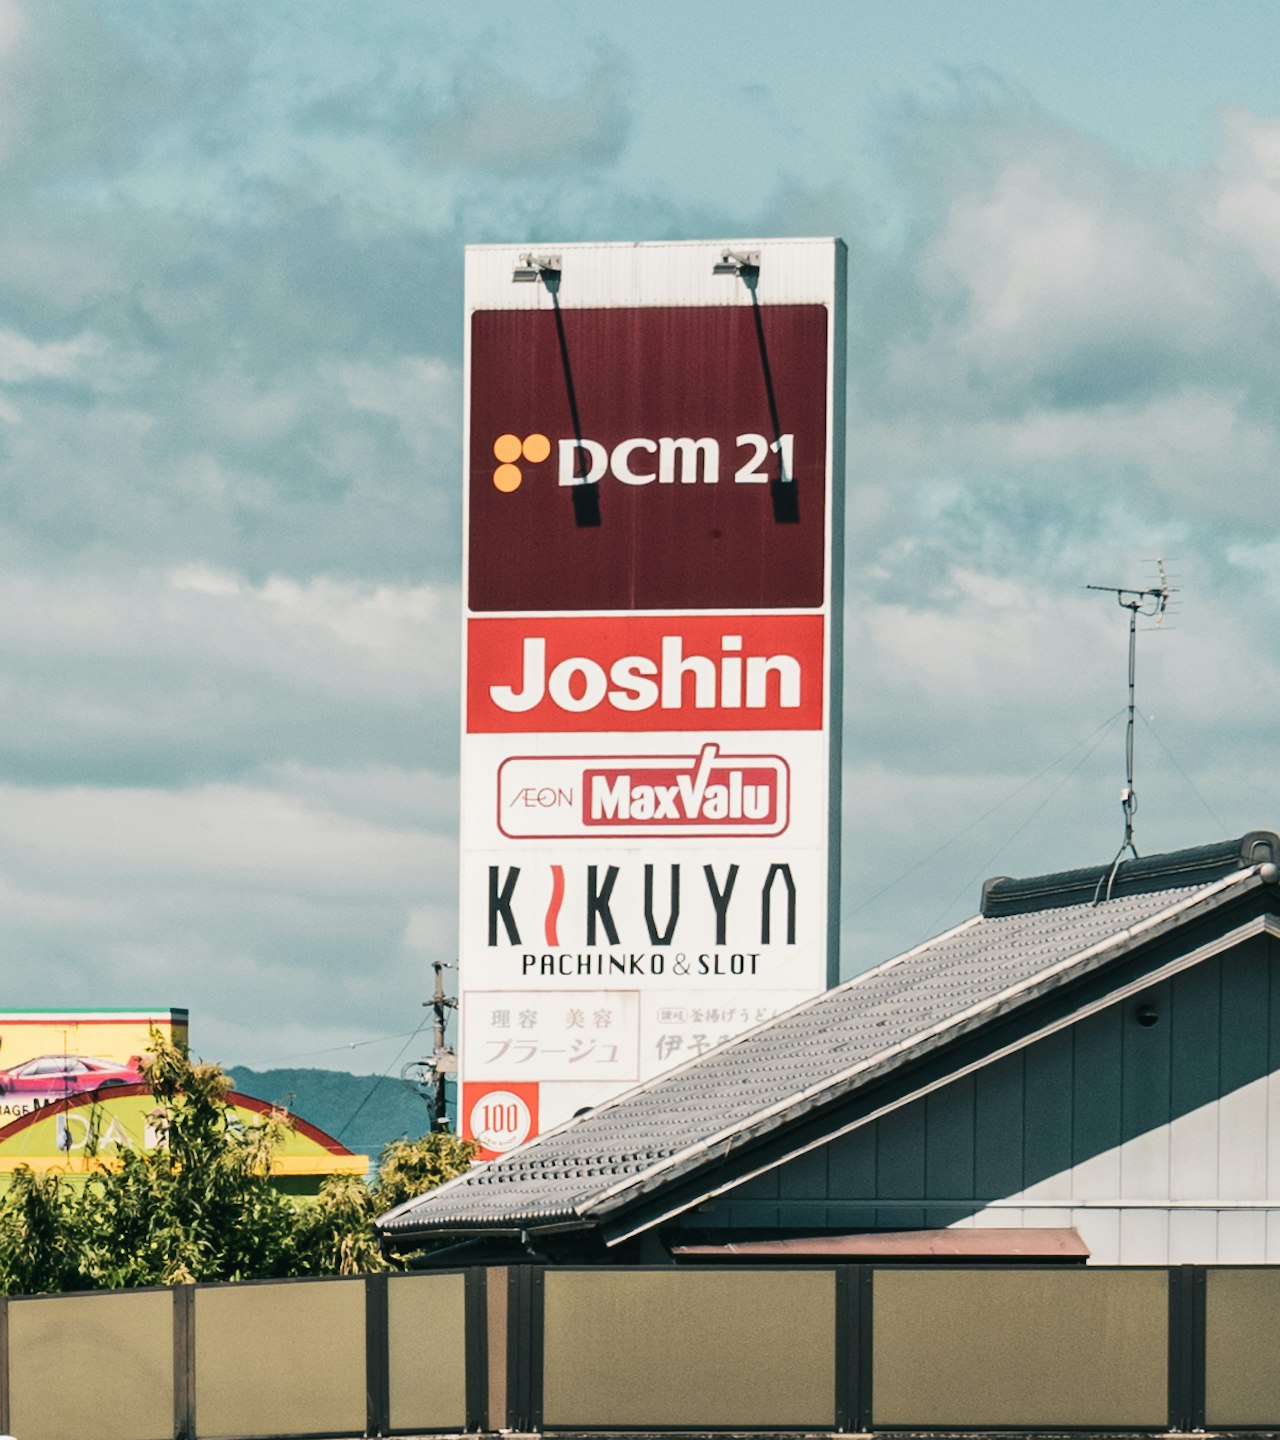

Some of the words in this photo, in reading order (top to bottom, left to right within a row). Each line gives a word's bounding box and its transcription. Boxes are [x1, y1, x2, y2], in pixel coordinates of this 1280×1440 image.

[734, 433, 795, 484] 21
[489, 635, 801, 712] Joshin
[591, 745, 770, 820] MaxValu
[522, 954, 665, 976] PACHINKO
[672, 953, 691, 976] &
[698, 954, 761, 975] SLOT
[491, 1009, 538, 1029] 理容
[565, 1009, 613, 1029] 美容
[483, 1103, 519, 1134] 100
